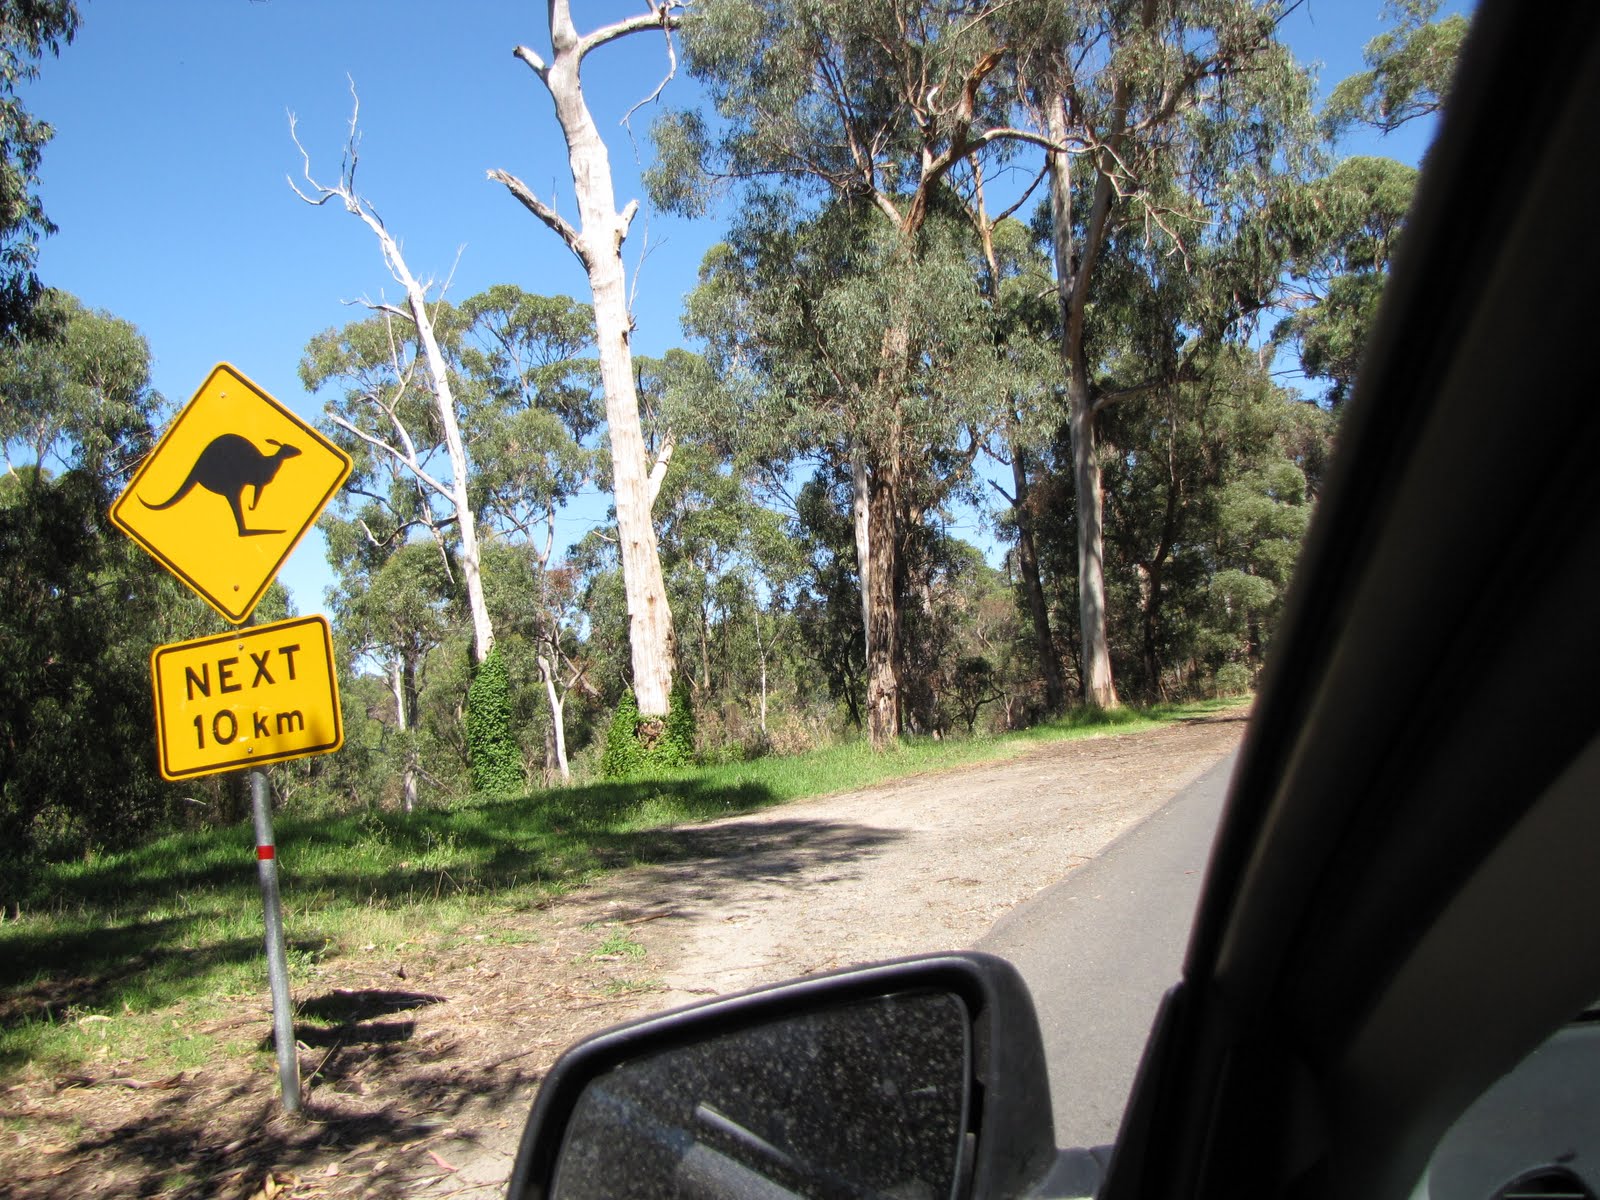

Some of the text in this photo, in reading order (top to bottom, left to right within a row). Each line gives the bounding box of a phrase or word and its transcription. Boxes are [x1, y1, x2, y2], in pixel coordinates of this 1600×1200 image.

[185, 644, 300, 700] NEXT
[193, 709, 305, 749] 10 km
